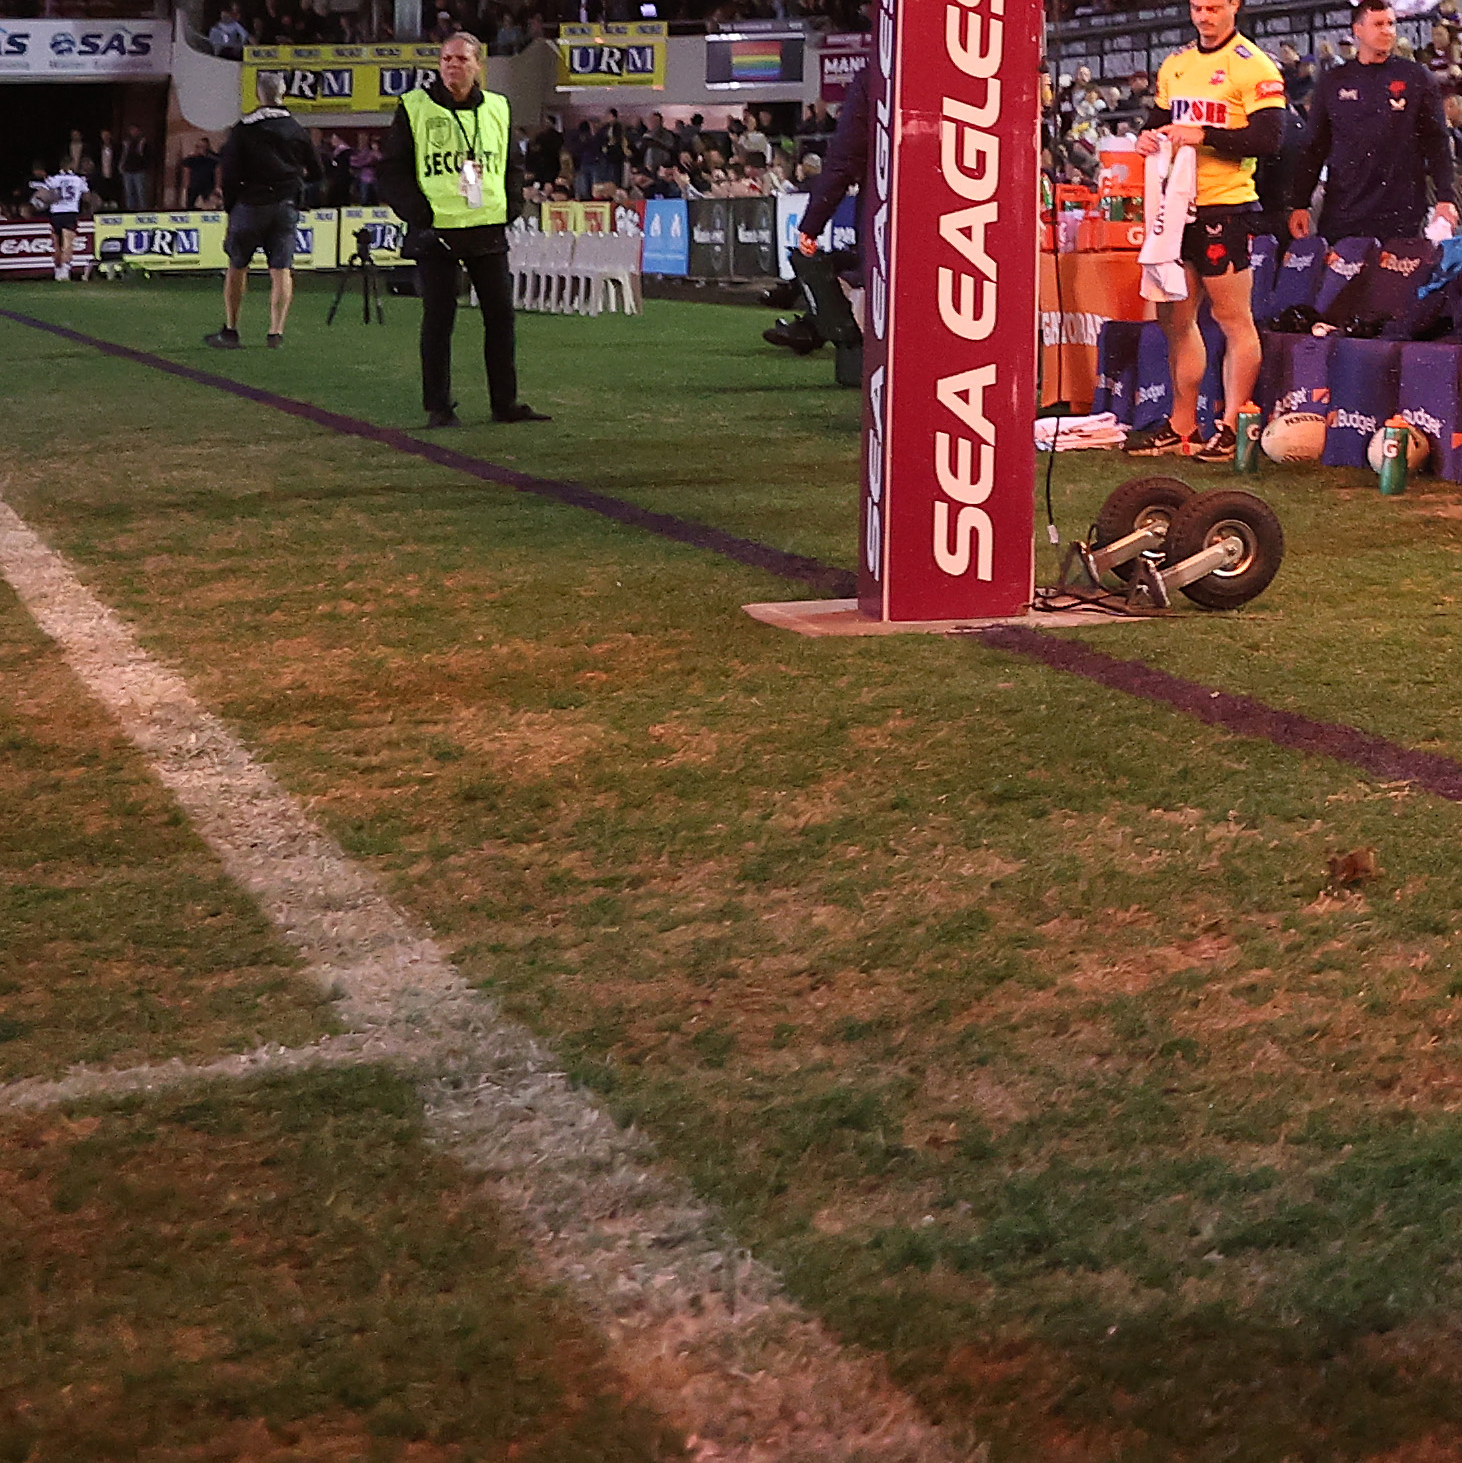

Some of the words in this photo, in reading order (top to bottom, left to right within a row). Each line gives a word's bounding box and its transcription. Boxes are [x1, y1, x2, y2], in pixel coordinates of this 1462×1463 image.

[569, 45, 655, 76] URM
[125, 228, 200, 255] URM
[1337, 408, 1377, 435] Budget
[1383, 438, 1399, 458] G
[867, 364, 885, 582] SEA
[933, 363, 998, 582] SEA
